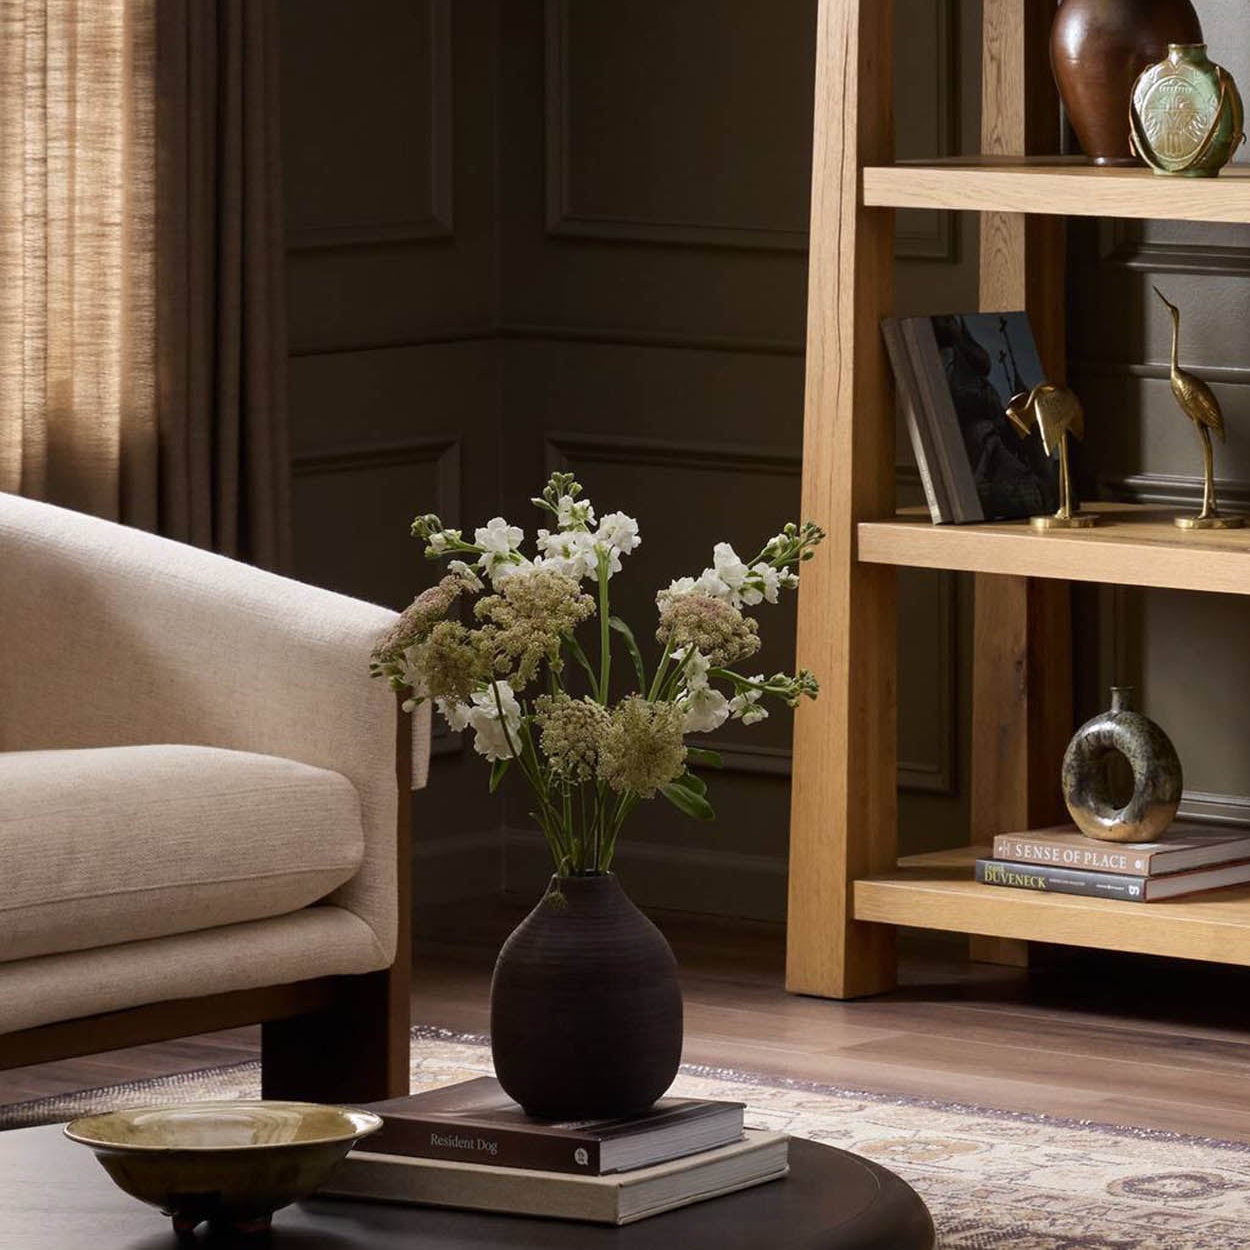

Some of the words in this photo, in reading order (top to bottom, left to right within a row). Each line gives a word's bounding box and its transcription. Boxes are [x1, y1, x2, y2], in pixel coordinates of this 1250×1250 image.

[1015, 844, 1060, 862] SENSE
[1063, 849, 1082, 864] OF
[1084, 853, 1127, 869] PLACE
[984, 869, 1046, 888] DUVENECK
[430, 1133, 475, 1150] Resident
[476, 1138, 498, 1155] Dog
